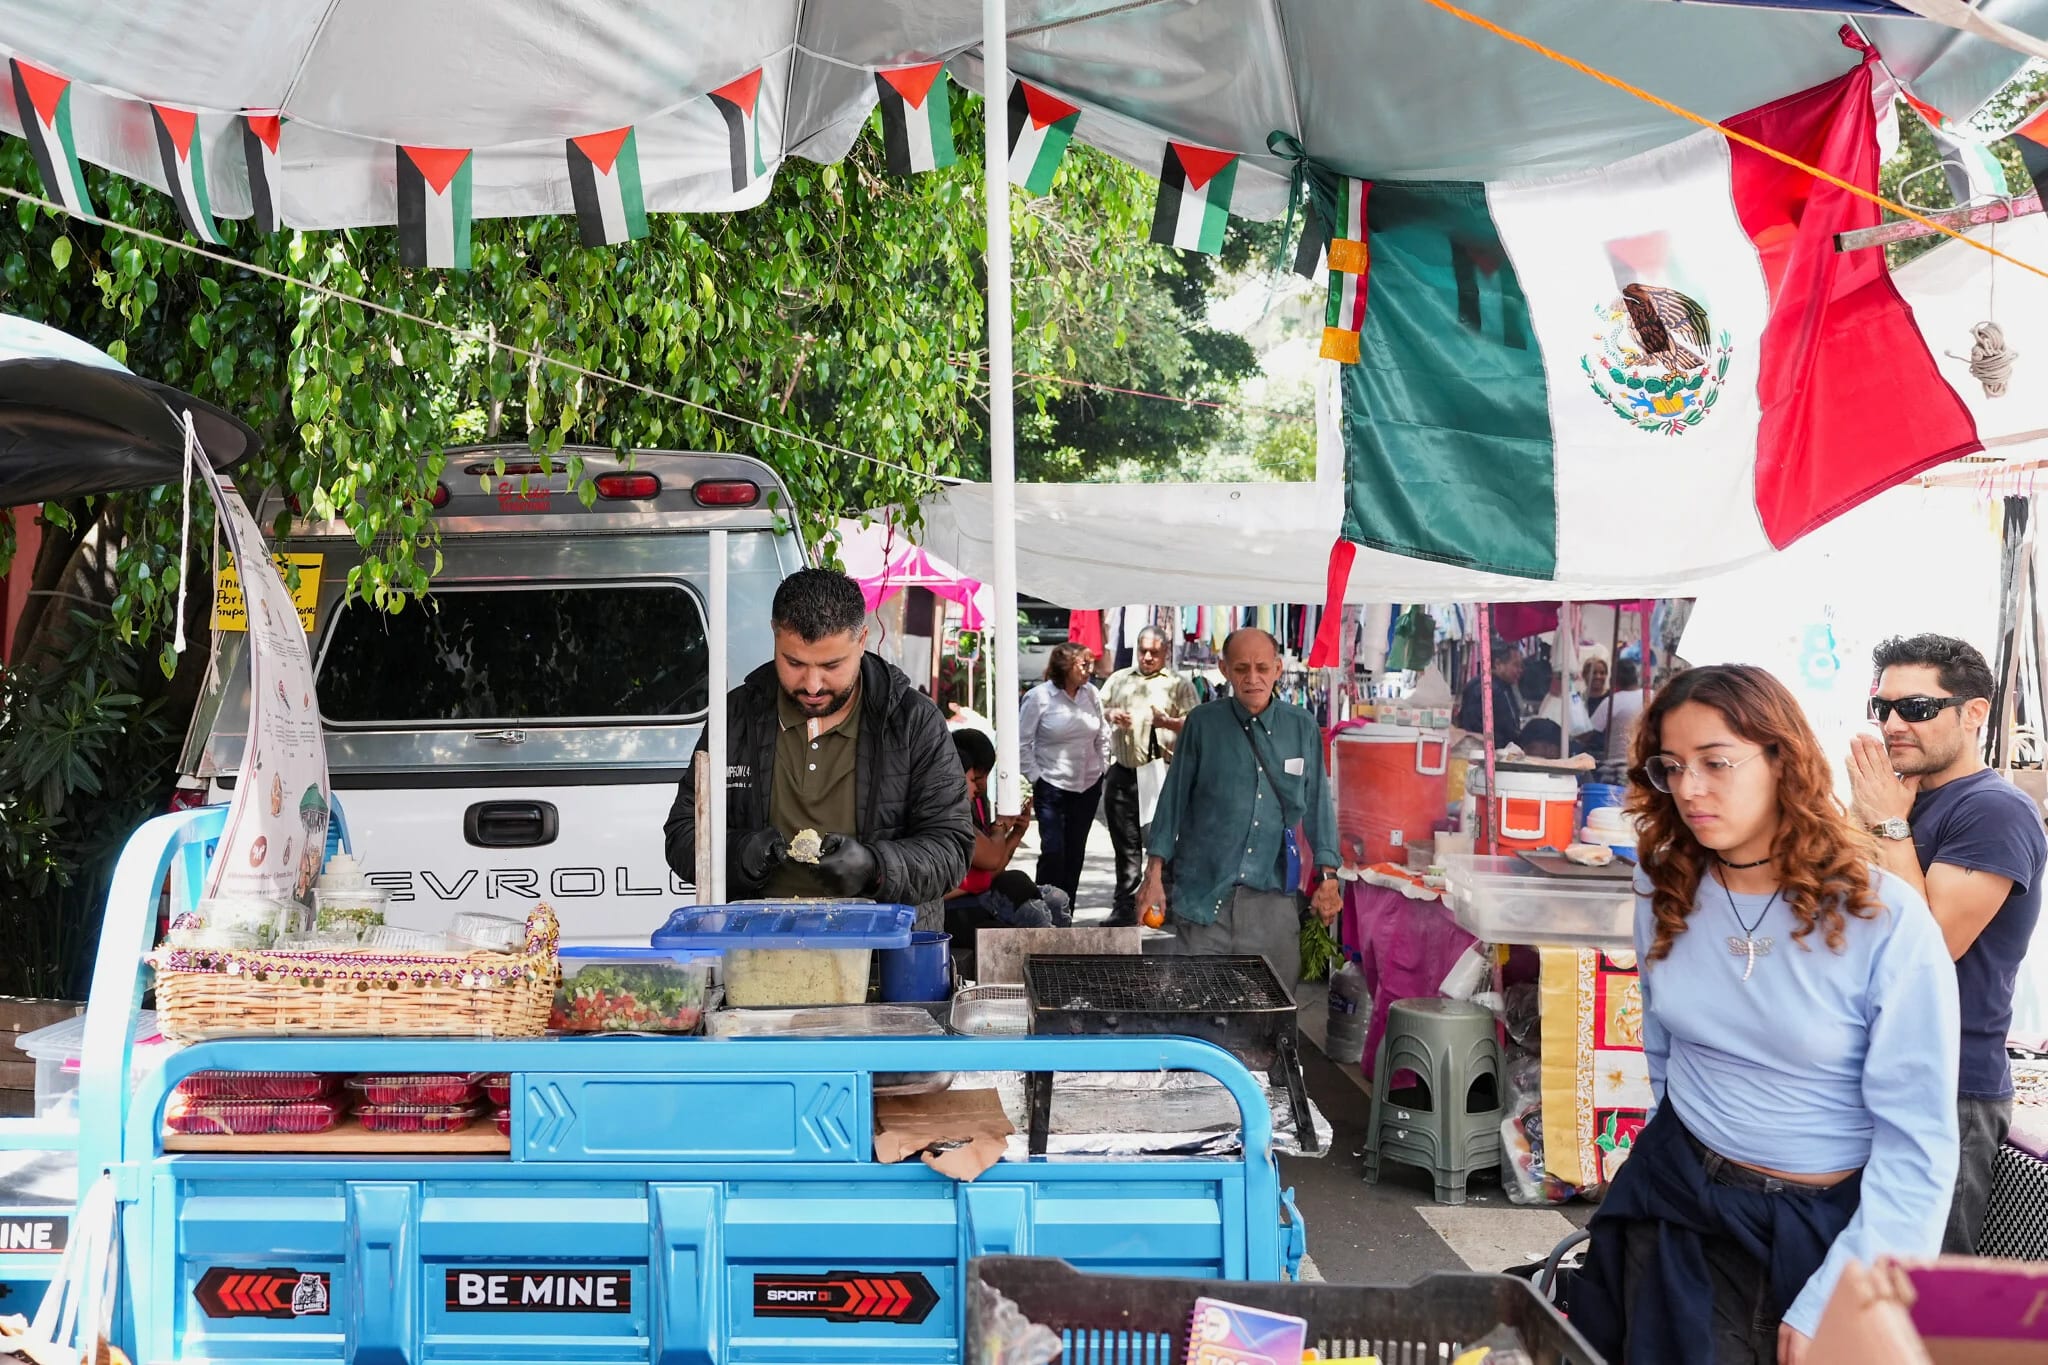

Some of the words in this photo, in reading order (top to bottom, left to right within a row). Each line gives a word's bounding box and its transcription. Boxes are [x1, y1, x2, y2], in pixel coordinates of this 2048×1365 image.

[217, 605, 246, 619] Grupo
[458, 1273, 509, 1306] BE
[521, 1275, 618, 1307] MINE
[767, 1289, 816, 1301] SPORT
